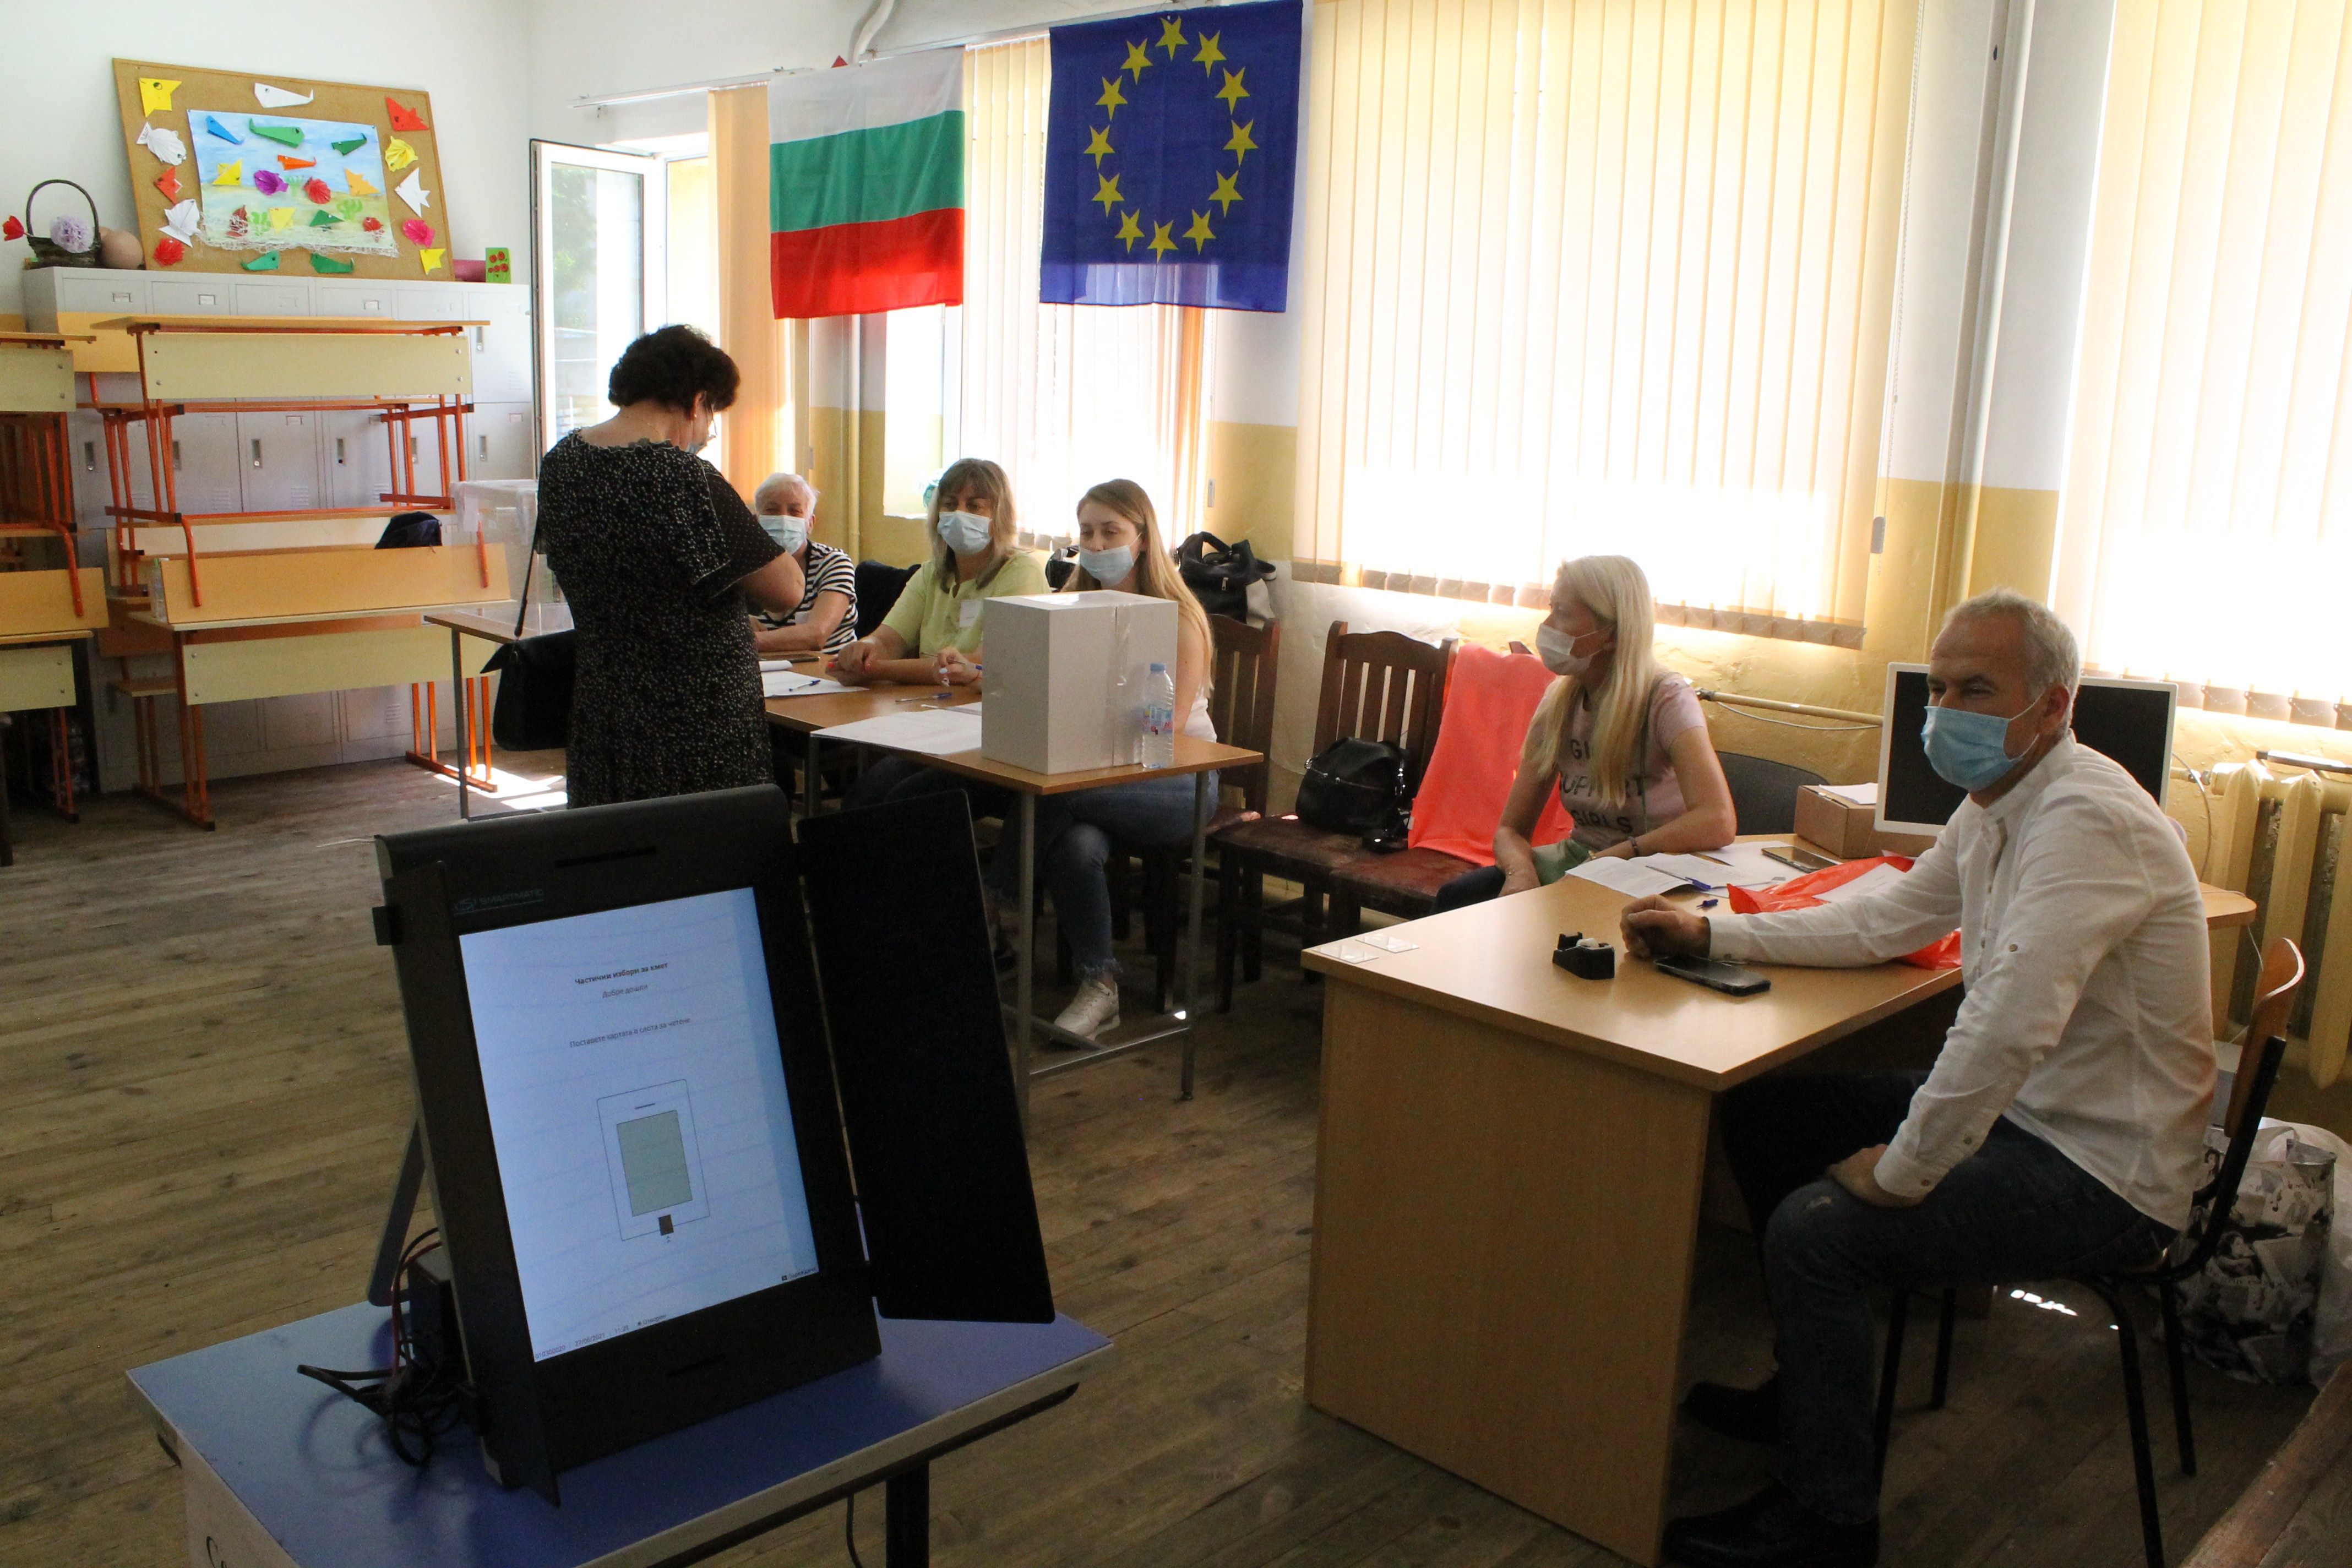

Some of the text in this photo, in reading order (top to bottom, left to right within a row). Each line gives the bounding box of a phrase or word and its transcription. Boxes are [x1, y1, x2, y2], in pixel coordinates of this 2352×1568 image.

[1571, 810, 1633, 833] GIRLS
[575, 973, 612, 984] Частични
[613, 968, 639, 977] избори
[602, 984, 648, 999] Добре дошли
[569, 1036, 606, 1048] Поставете
[607, 1030, 633, 1041] картата
[639, 1024, 658, 1033] слота
[668, 1017, 691, 1027] четене
[575, 1333, 605, 1347] 27/06/2021
